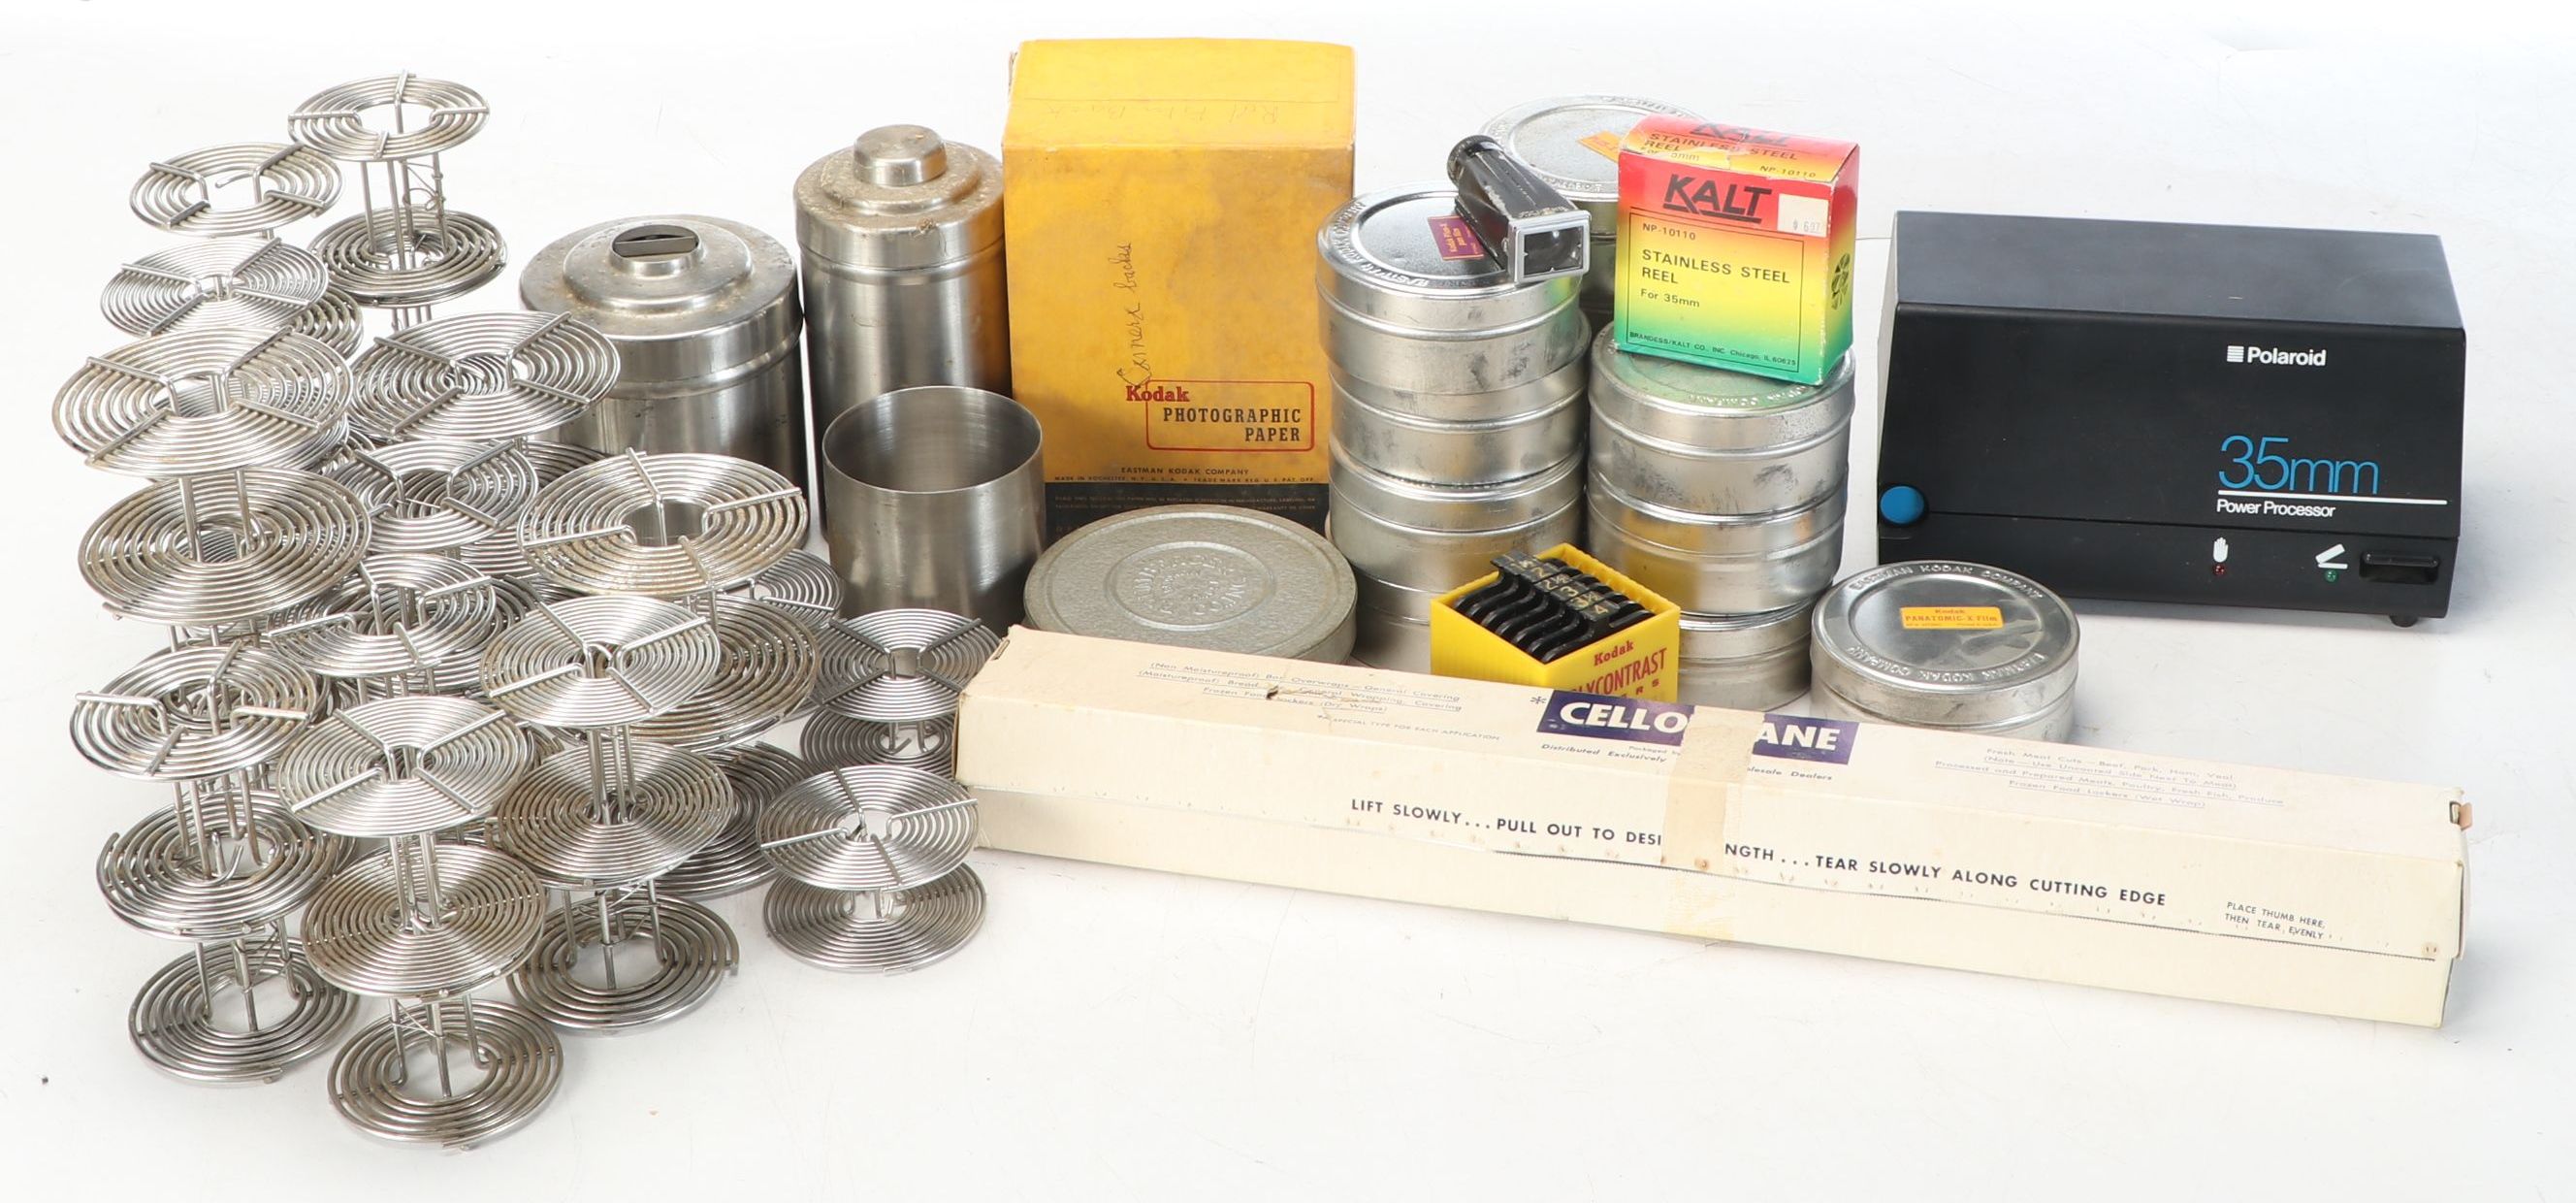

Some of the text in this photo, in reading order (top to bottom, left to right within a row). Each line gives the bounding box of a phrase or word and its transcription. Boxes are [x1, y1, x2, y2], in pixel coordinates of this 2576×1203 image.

[1644, 140, 1681, 152] REEL
[1649, 132, 1798, 161] STAINLESS STEEL
[1759, 164, 1817, 179] NP-10110
[1663, 173, 1773, 223] KALT
[1642, 222, 1696, 242] NP-10110
[1642, 248, 1790, 284] STAINLESS STEEL
[1642, 267, 1679, 285] REEL
[1640, 288, 1701, 309] For 35mm
[2247, 345, 2327, 367] Polaroid
[1125, 384, 1190, 403] Kodak
[1163, 406, 1302, 424] PHOTOGRAPHIC
[1244, 427, 1301, 442] PAPER
[1121, 466, 1250, 476] EASTMAN KODAK COMPANY
[2218, 435, 2379, 495] 35mm
[2216, 498, 2336, 518] Power Processor
[1919, 564, 1974, 574] KODAK
[1980, 570, 2044, 600] COMPANY
[1593, 602, 1609, 615] 4
[1594, 639, 1634, 667] Kodak
[1571, 647, 1667, 695] YCONTRAST
[1203, 686, 1239, 697] Frozen
[1412, 690, 1461, 702] Covering
[1440, 730, 1501, 741] APPLICATION
[1558, 700, 1842, 752] CELLOANE
[1540, 743, 1600, 756] Distributed
[1607, 750, 1667, 764] Exclusively
[1790, 770, 1833, 782] Dealers
[1351, 797, 1384, 814] LIFT
[1497, 817, 1538, 834] PULL
[1546, 822, 1583, 838] OUT
[1592, 827, 1616, 841] TO
[1626, 830, 1662, 847] DESI
[1816, 854, 1859, 872] TEAR
[1868, 861, 1943, 880] SLOWLY
[1951, 868, 2019, 889] ALONG
[2029, 876, 2109, 900] CUTTING
[2119, 890, 2168, 908] EDGE
[2226, 901, 2258, 915] PLACE
[2261, 908, 2295, 923] THUMB
[2224, 912, 2326, 941] THEN TEAR EVENLY
